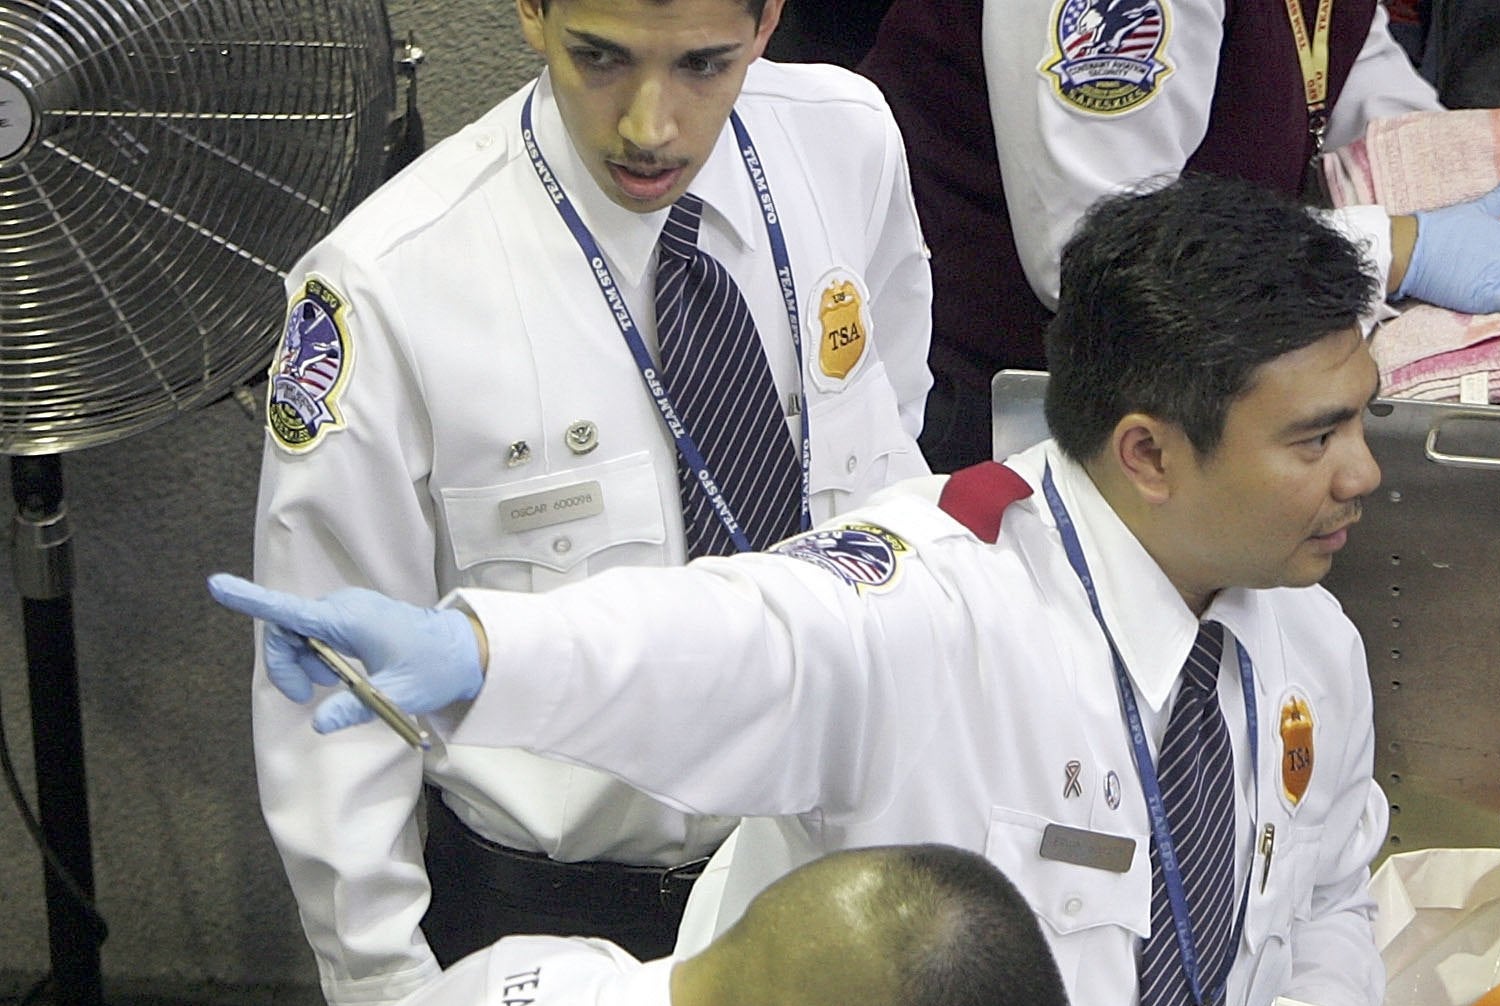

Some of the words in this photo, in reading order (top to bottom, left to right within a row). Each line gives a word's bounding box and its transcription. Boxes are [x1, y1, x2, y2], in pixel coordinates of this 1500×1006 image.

[523, 128, 543, 161] SFO
[535, 160, 565, 204] TEAM
[742, 145, 766, 191] TEAM
[761, 192, 777, 224] SFO
[591, 256, 614, 292] SFO
[779, 266, 796, 313] TEAM
[606, 290, 633, 331] TEAM
[829, 323, 861, 352] TSA
[644, 368, 665, 397] SFO
[657, 393, 686, 438] TEAM
[698, 469, 721, 496] SFO
[711, 493, 740, 534] TEAM
[1288, 747, 1310, 772] TSA
